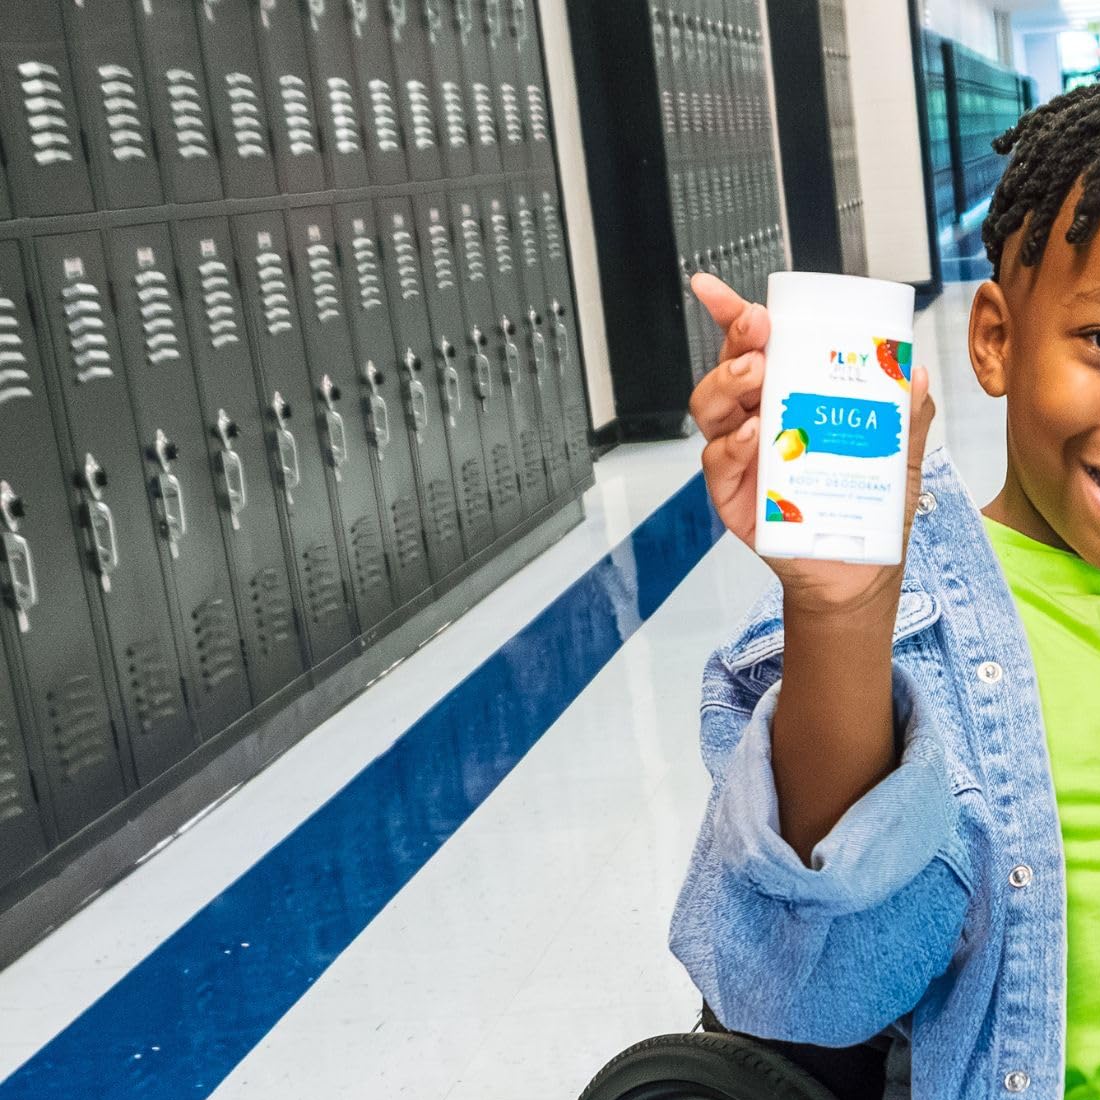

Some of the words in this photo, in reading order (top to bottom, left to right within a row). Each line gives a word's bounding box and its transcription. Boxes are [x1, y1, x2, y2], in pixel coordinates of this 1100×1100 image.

[830, 350, 869, 367] PLAY
[814, 405, 877, 430] SUGA
[826, 478, 891, 493] DEODORANT
